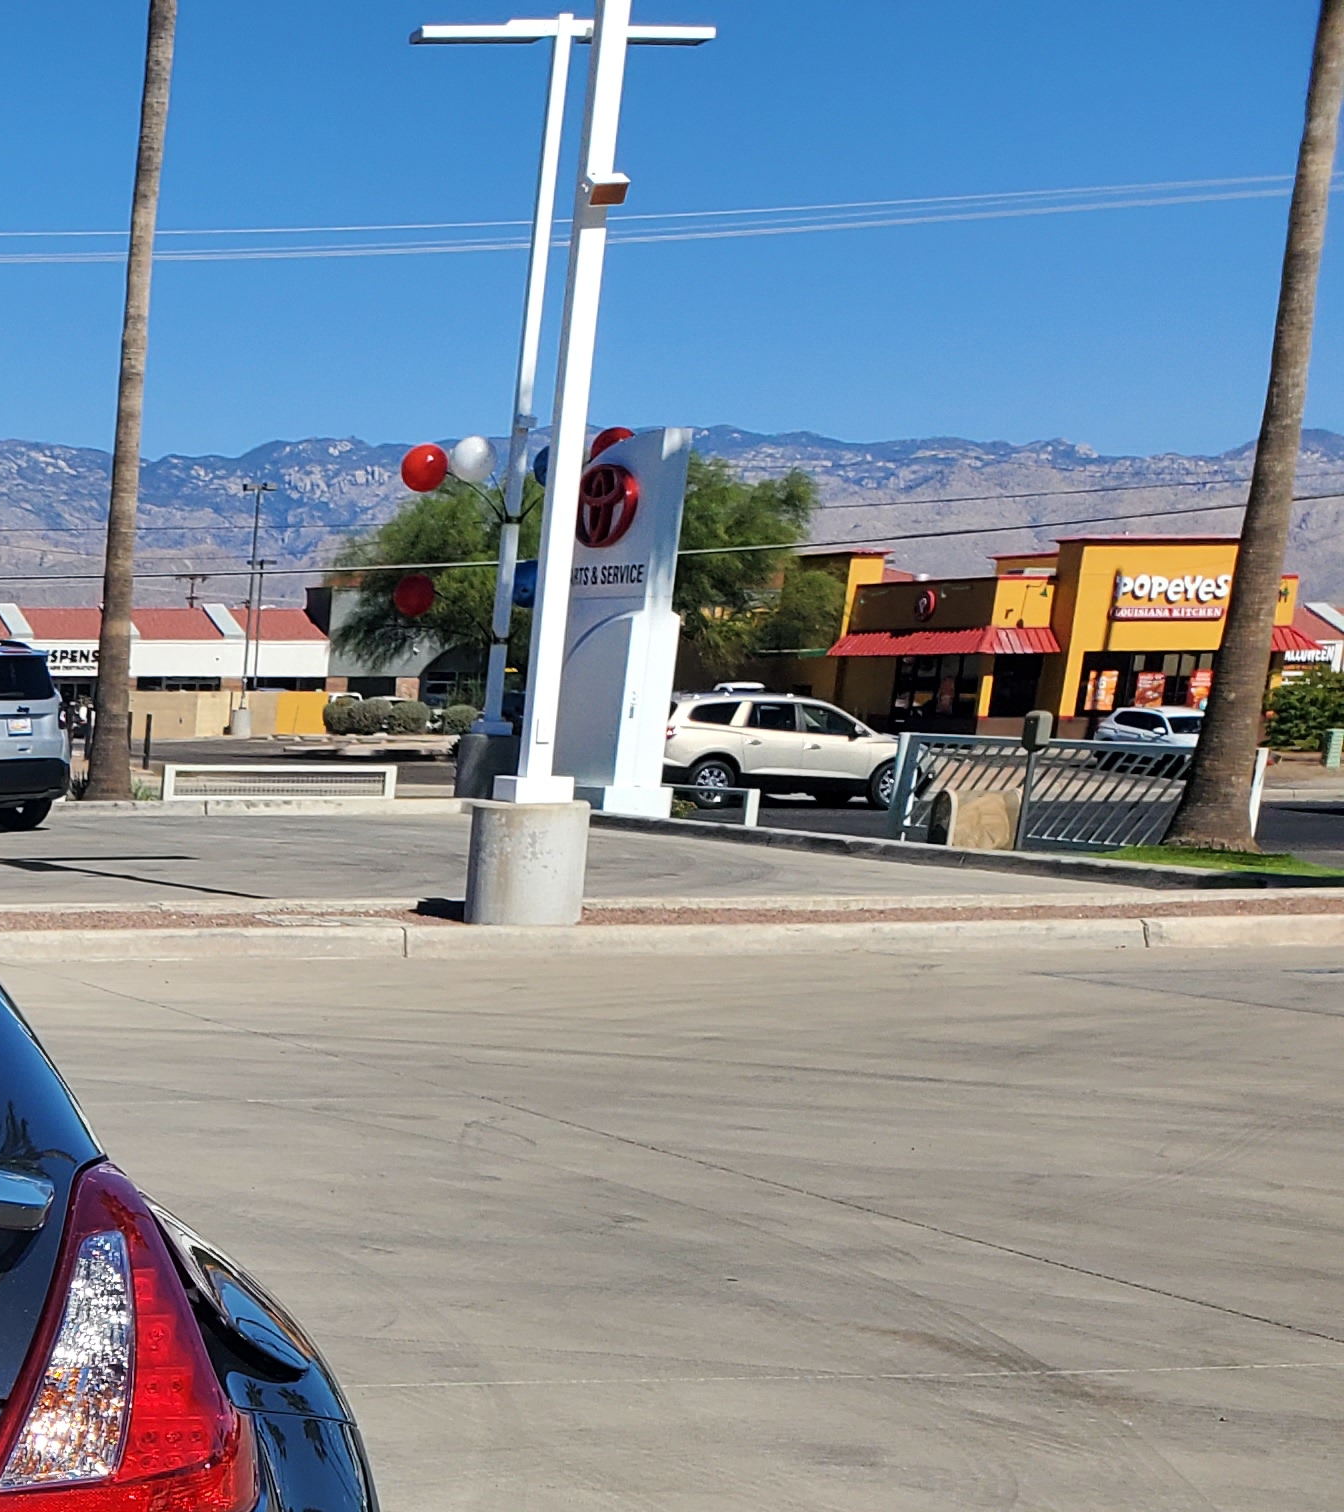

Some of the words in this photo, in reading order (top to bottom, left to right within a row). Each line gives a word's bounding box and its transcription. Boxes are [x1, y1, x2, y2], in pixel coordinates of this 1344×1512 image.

[571, 567, 589, 585] RTS
[591, 566, 598, 585] &
[600, 564, 644, 584] SERVICE
[1115, 607, 1169, 617] LOUISIANA
[1173, 607, 1222, 617] KITCHEN
[47, 649, 100, 663] SPENS
